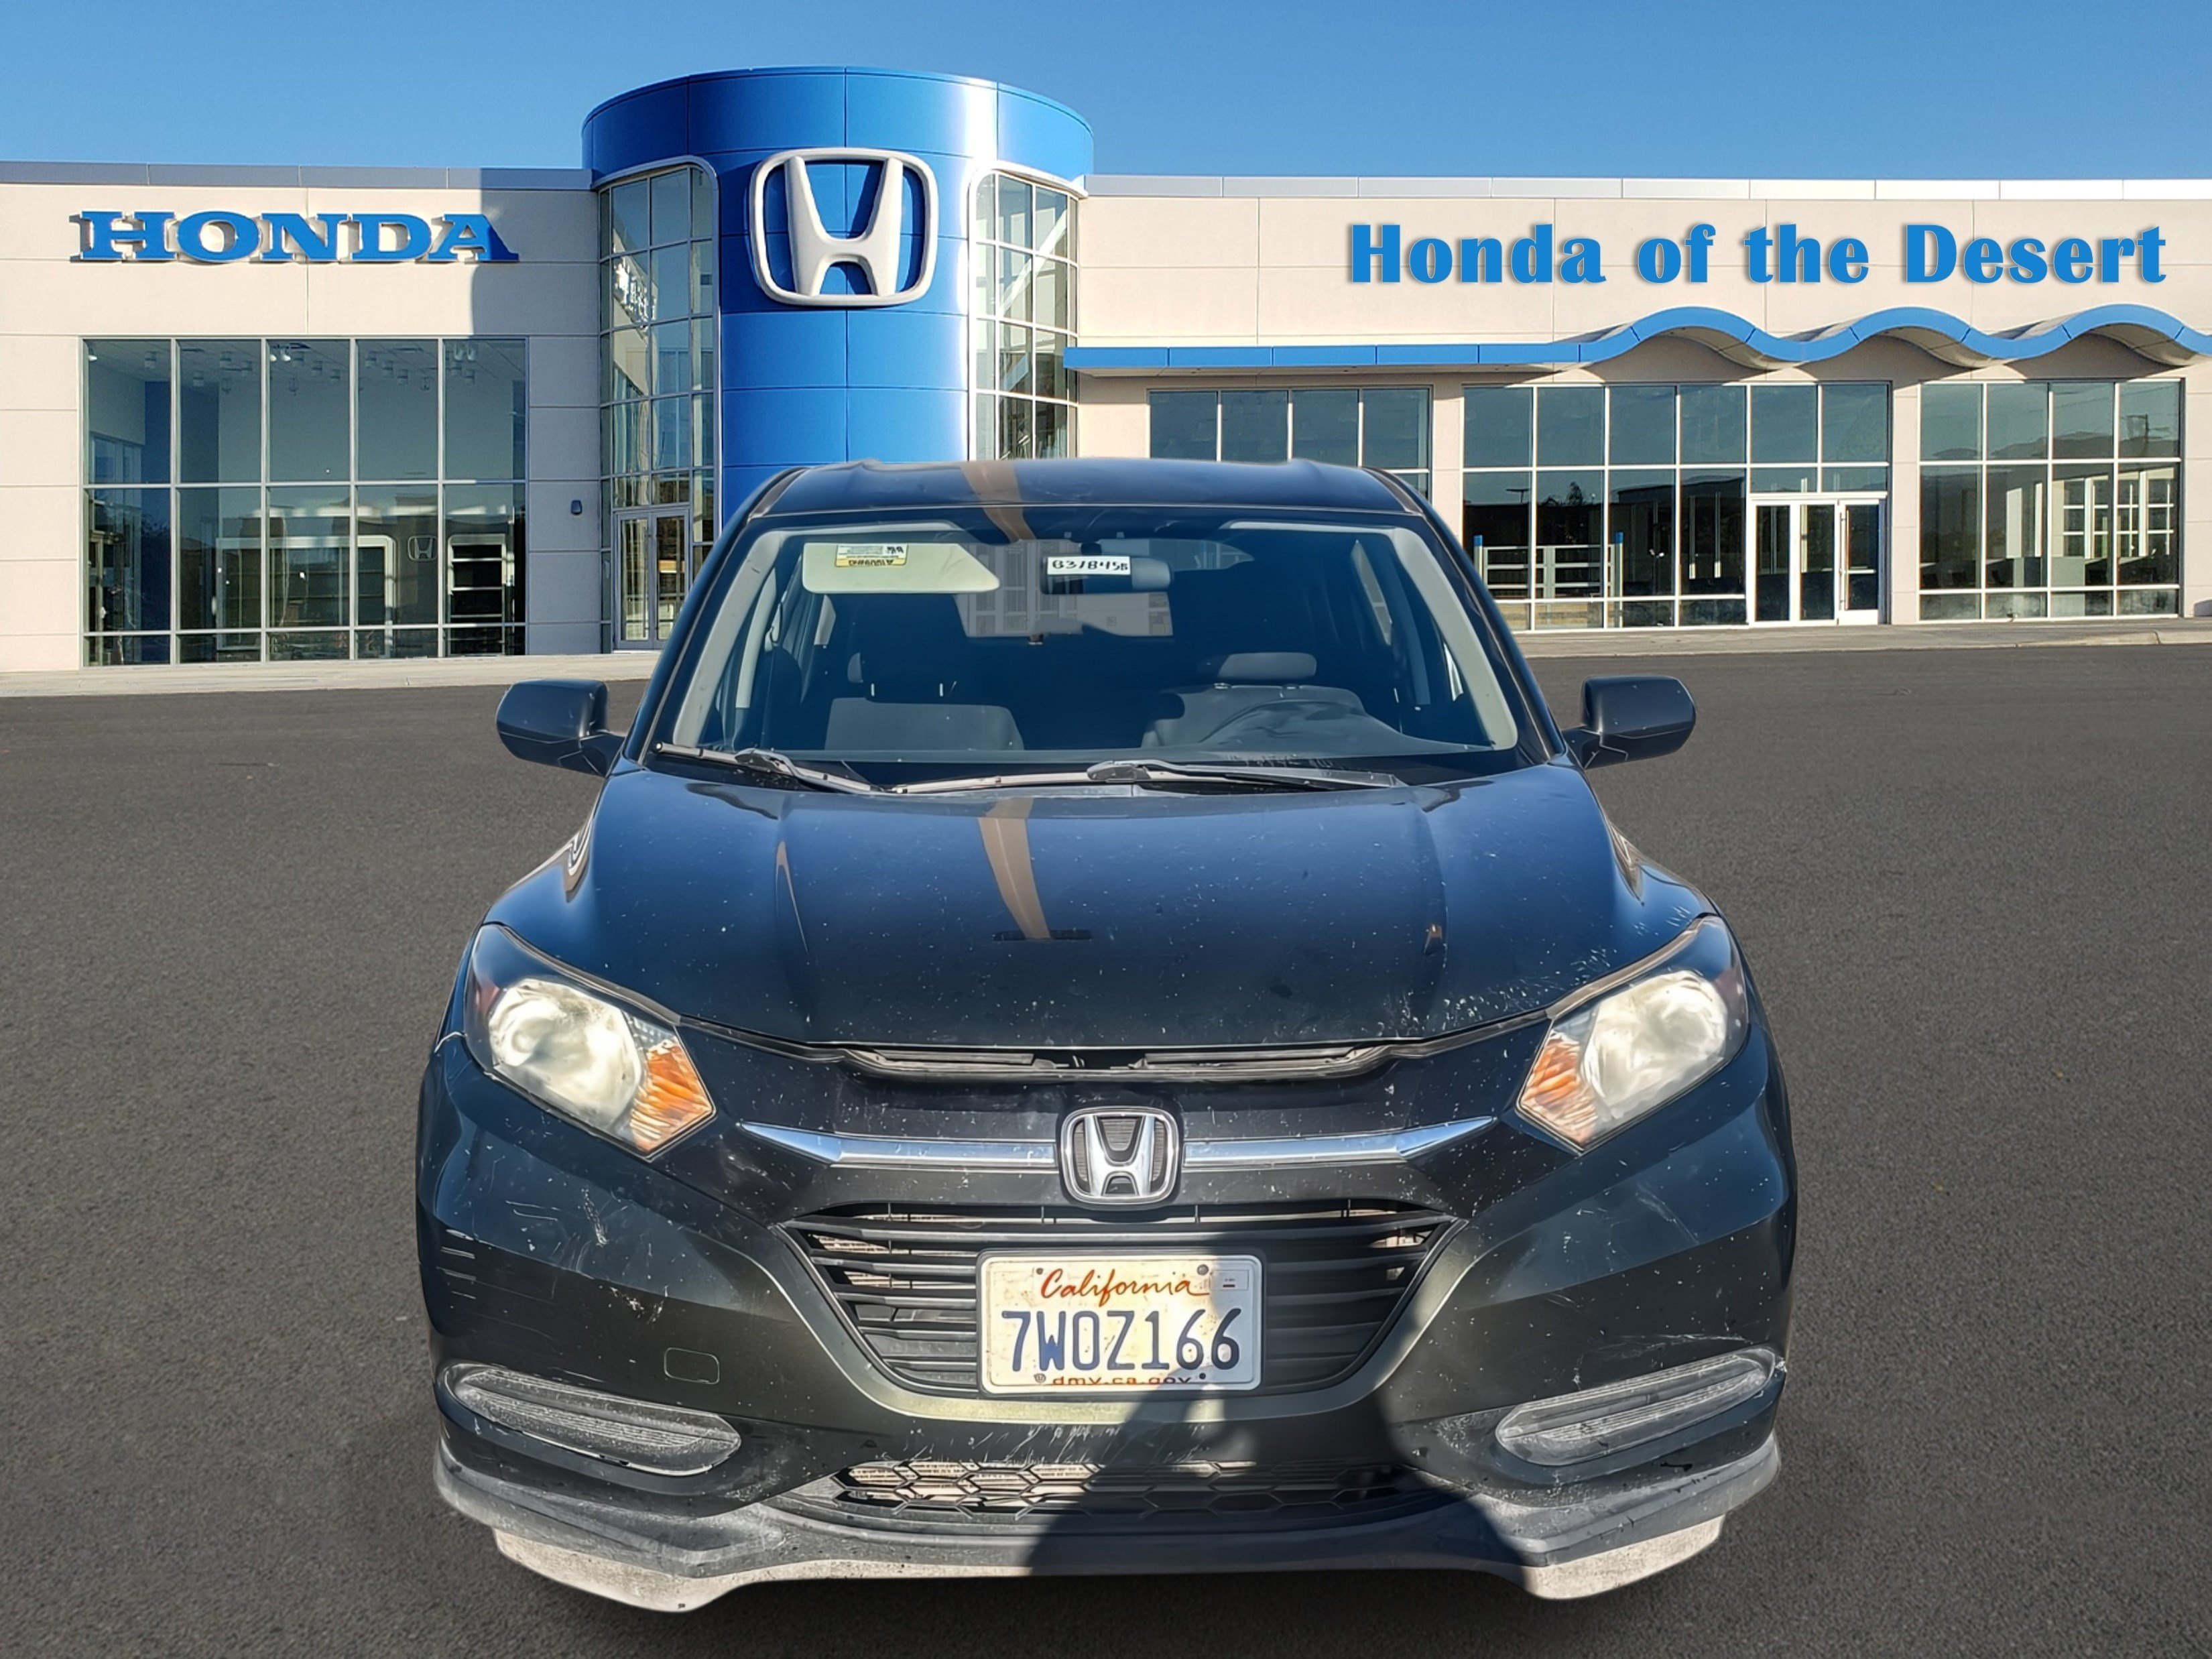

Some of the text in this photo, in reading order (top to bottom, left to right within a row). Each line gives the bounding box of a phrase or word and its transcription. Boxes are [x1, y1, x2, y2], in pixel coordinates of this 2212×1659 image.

[80, 210, 519, 262] HONDA
[1351, 224, 2167, 284] Honda of the Desert
[1040, 1268, 1211, 1307] California
